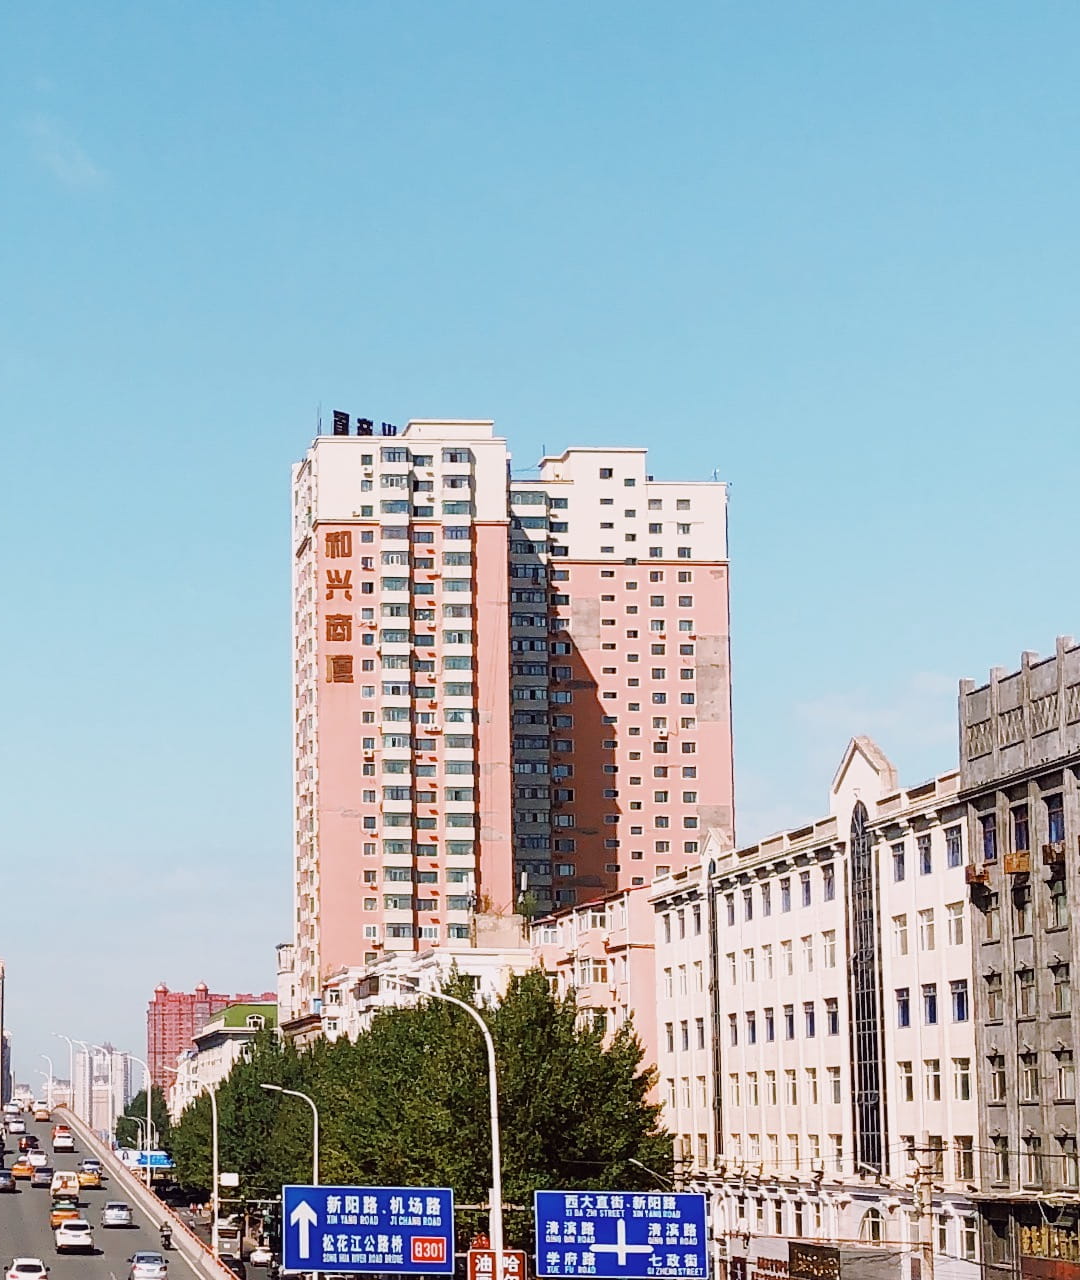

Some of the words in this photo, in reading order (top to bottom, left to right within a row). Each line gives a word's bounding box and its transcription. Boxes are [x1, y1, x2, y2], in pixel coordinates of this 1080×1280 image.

[325, 530, 354, 683] 和兴商厦
[599, 1209, 625, 1218] STREET
[360, 1215, 379, 1225] ROAD
[389, 1216, 398, 1226] JI
[422, 1216, 442, 1226] ROAD
[678, 1267, 704, 1276] STREET
